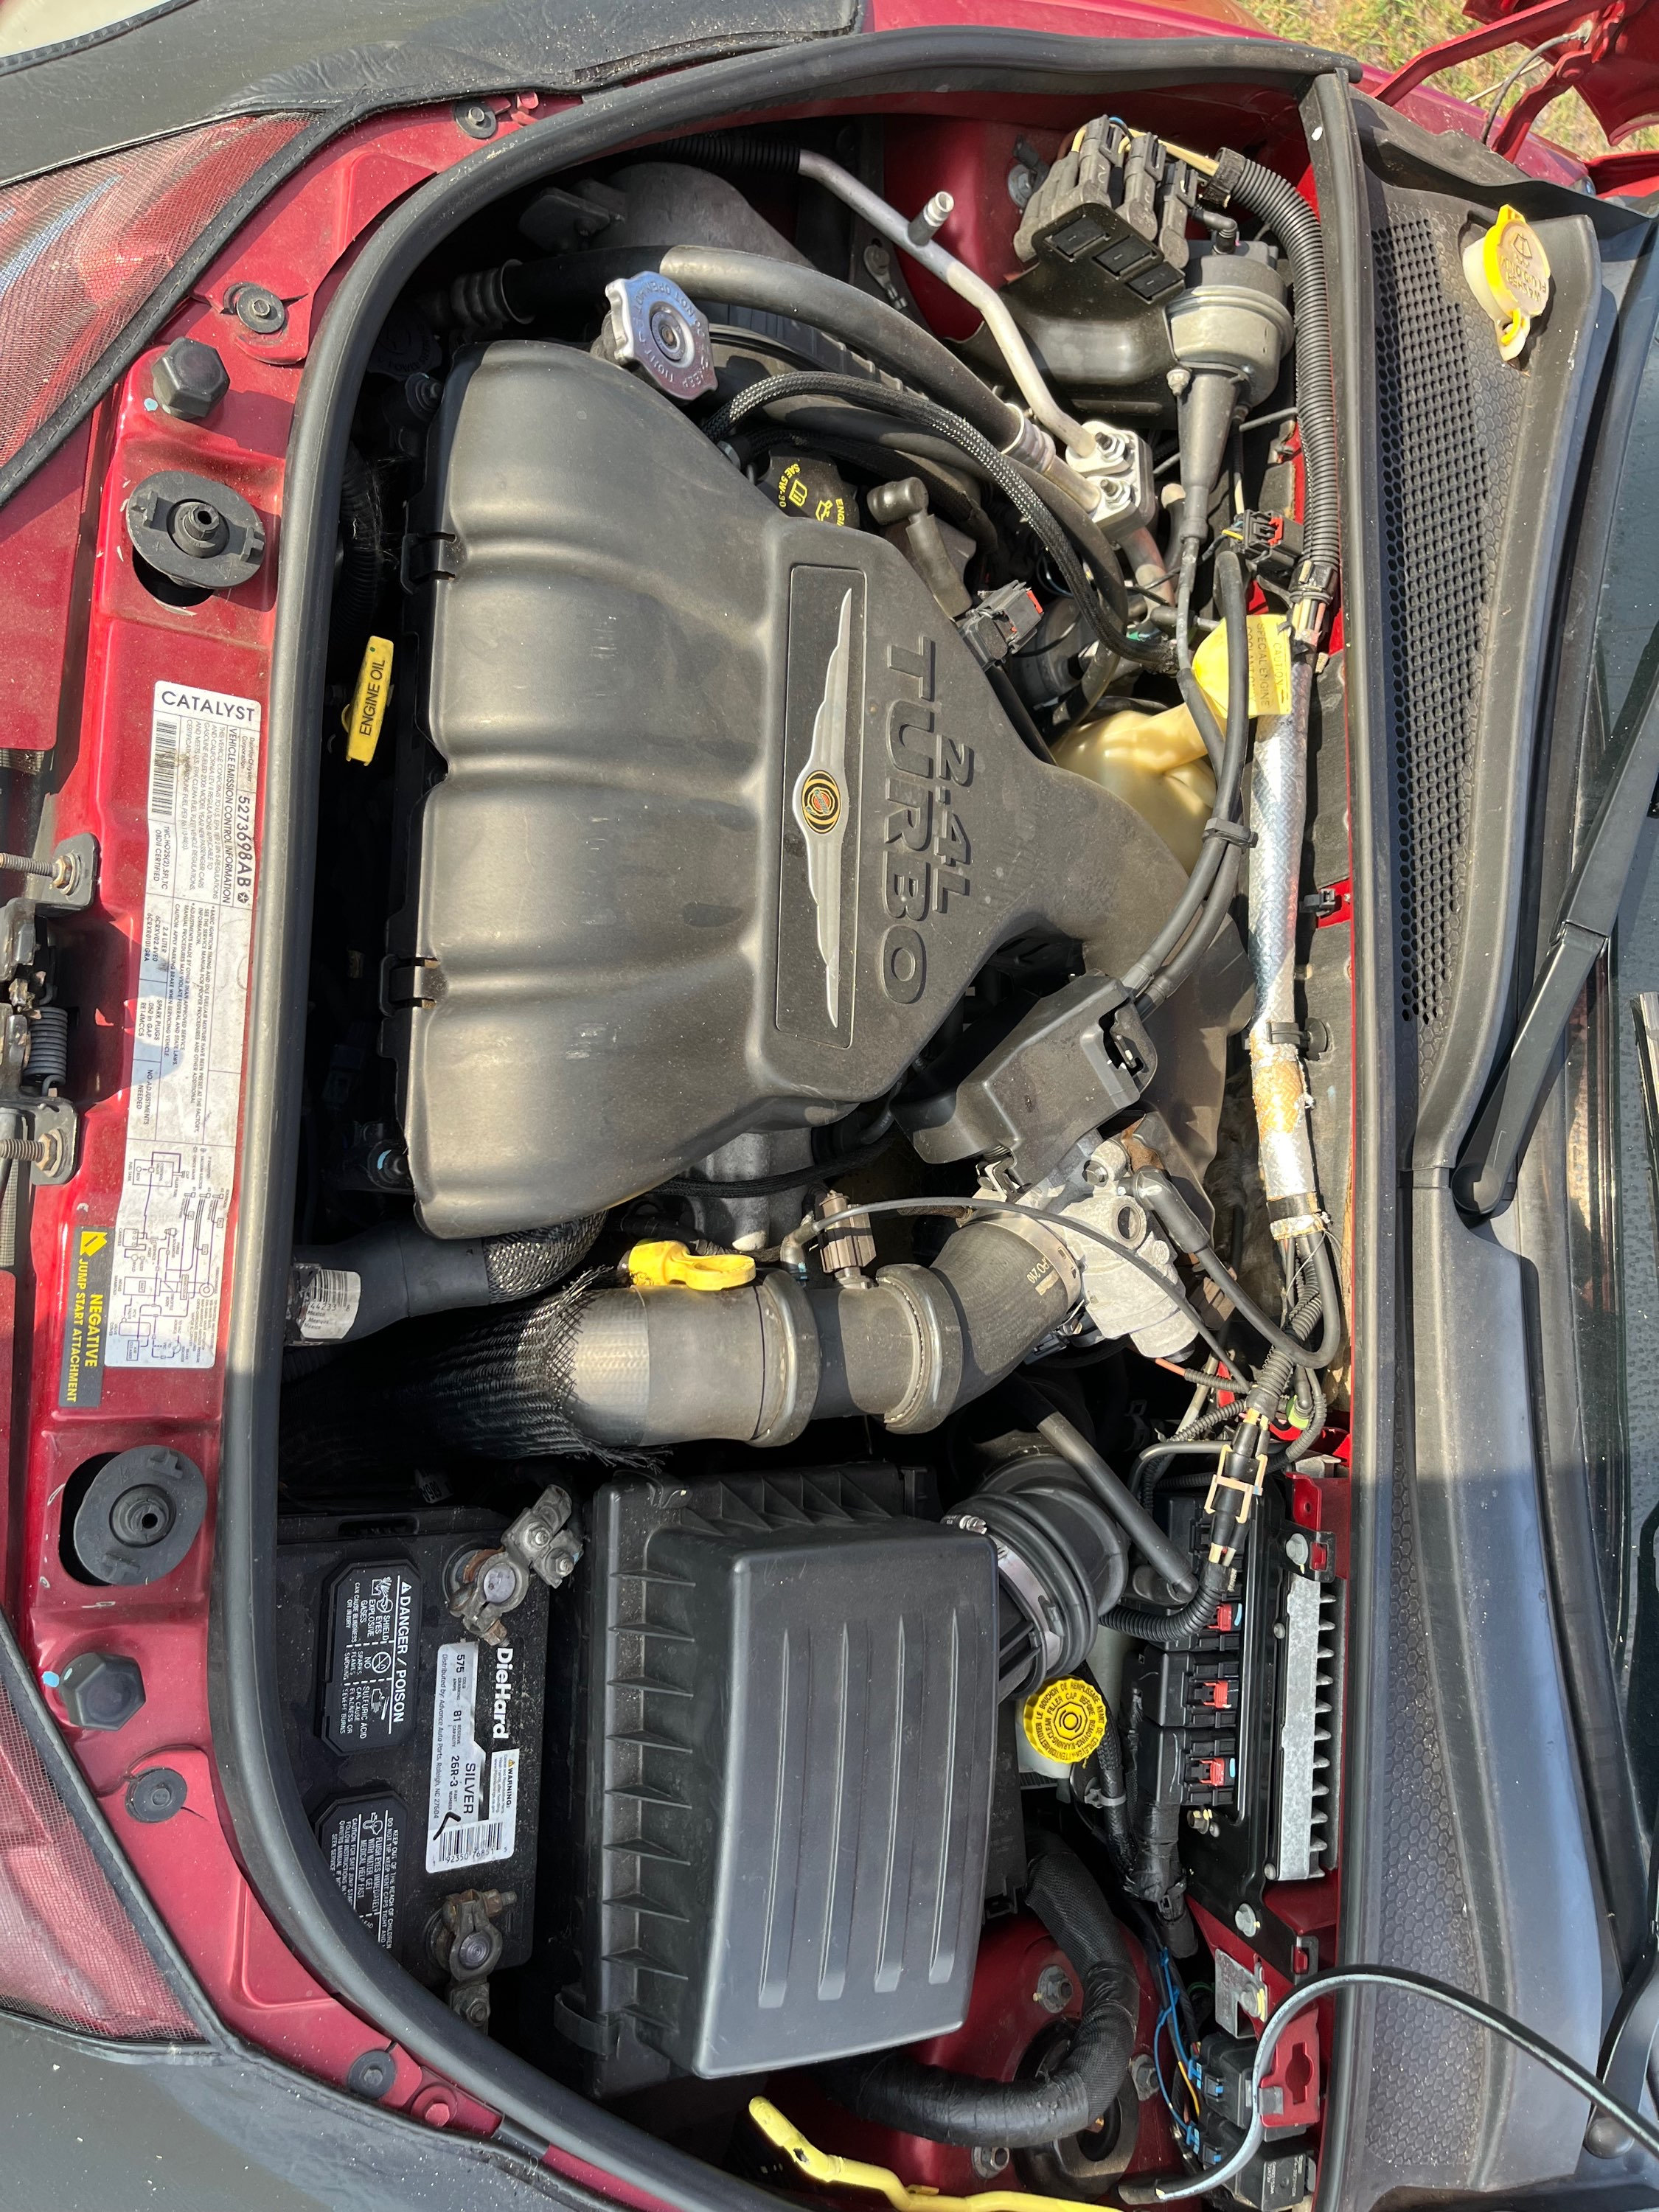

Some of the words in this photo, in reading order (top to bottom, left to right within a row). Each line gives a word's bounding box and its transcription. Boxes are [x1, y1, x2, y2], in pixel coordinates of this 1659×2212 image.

[1506, 271, 1541, 302] WASHER
[785, 464, 800, 479] SAE
[1256, 623, 1267, 665] SPECIAL
[1273, 643, 1283, 685] CAUTION
[360, 683, 380, 736] ENGINE
[371, 661, 385, 680] OIL
[1259, 668, 1270, 706] ENGINE
[162, 691, 254, 721] CATALYST
[228, 728, 237, 761] VEHICLE
[246, 737, 255, 782] DaimlerChrysler
[226, 764, 236, 802] EMISSION
[223, 805, 234, 844] CONTROL
[883, 636, 935, 1004] TURBO
[933, 734, 973, 913] 2.4L
[237, 796, 252, 886] 5273698AB
[223, 845, 233, 902] INFORMATION
[147, 1070, 153, 1079] NO
[144, 1082, 152, 1124] ADJUSTMENTS
[77, 1259, 88, 1289] JUMP
[1027, 1267, 1040, 1284] 210
[74, 1293, 85, 1325] START
[85, 1294, 103, 1366] NEGATIVE
[67, 1329, 81, 1402] ATTACHMENT
[347, 1599, 352, 1607] OR
[367, 1599, 375, 1637] EXPLOSIVE
[382, 1615, 391, 1640] SHIELD
[397, 1596, 411, 1653] DANGER
[364, 1656, 372, 1668] NO
[456, 1655, 465, 1672] 575
[361, 1686, 370, 1719] SULFURIC
[393, 1669, 407, 1722] POISON
[493, 1647, 513, 1738] DieHard
[1036, 1711, 1043, 1719] LE
[1040, 1688, 1059, 1710] BOUCHON
[1047, 1696, 1063, 1715] FILLER
[1065, 1692, 1077, 1700] CAP
[1079, 1695, 1096, 1717] BEFORE
[347, 1724, 353, 1733] OR
[453, 1711, 462, 1721] 81
[450, 1756, 460, 1787] 26R-3
[463, 1763, 476, 1813] SILVER
[435, 1788, 441, 1796] NC
[388, 1818, 394, 1826] DO
[341, 1845, 350, 1883] INSTRUCTIONS
[359, 1840, 367, 1864] MEDICAL
[372, 1874, 380, 1913] IMMEDIATELY
